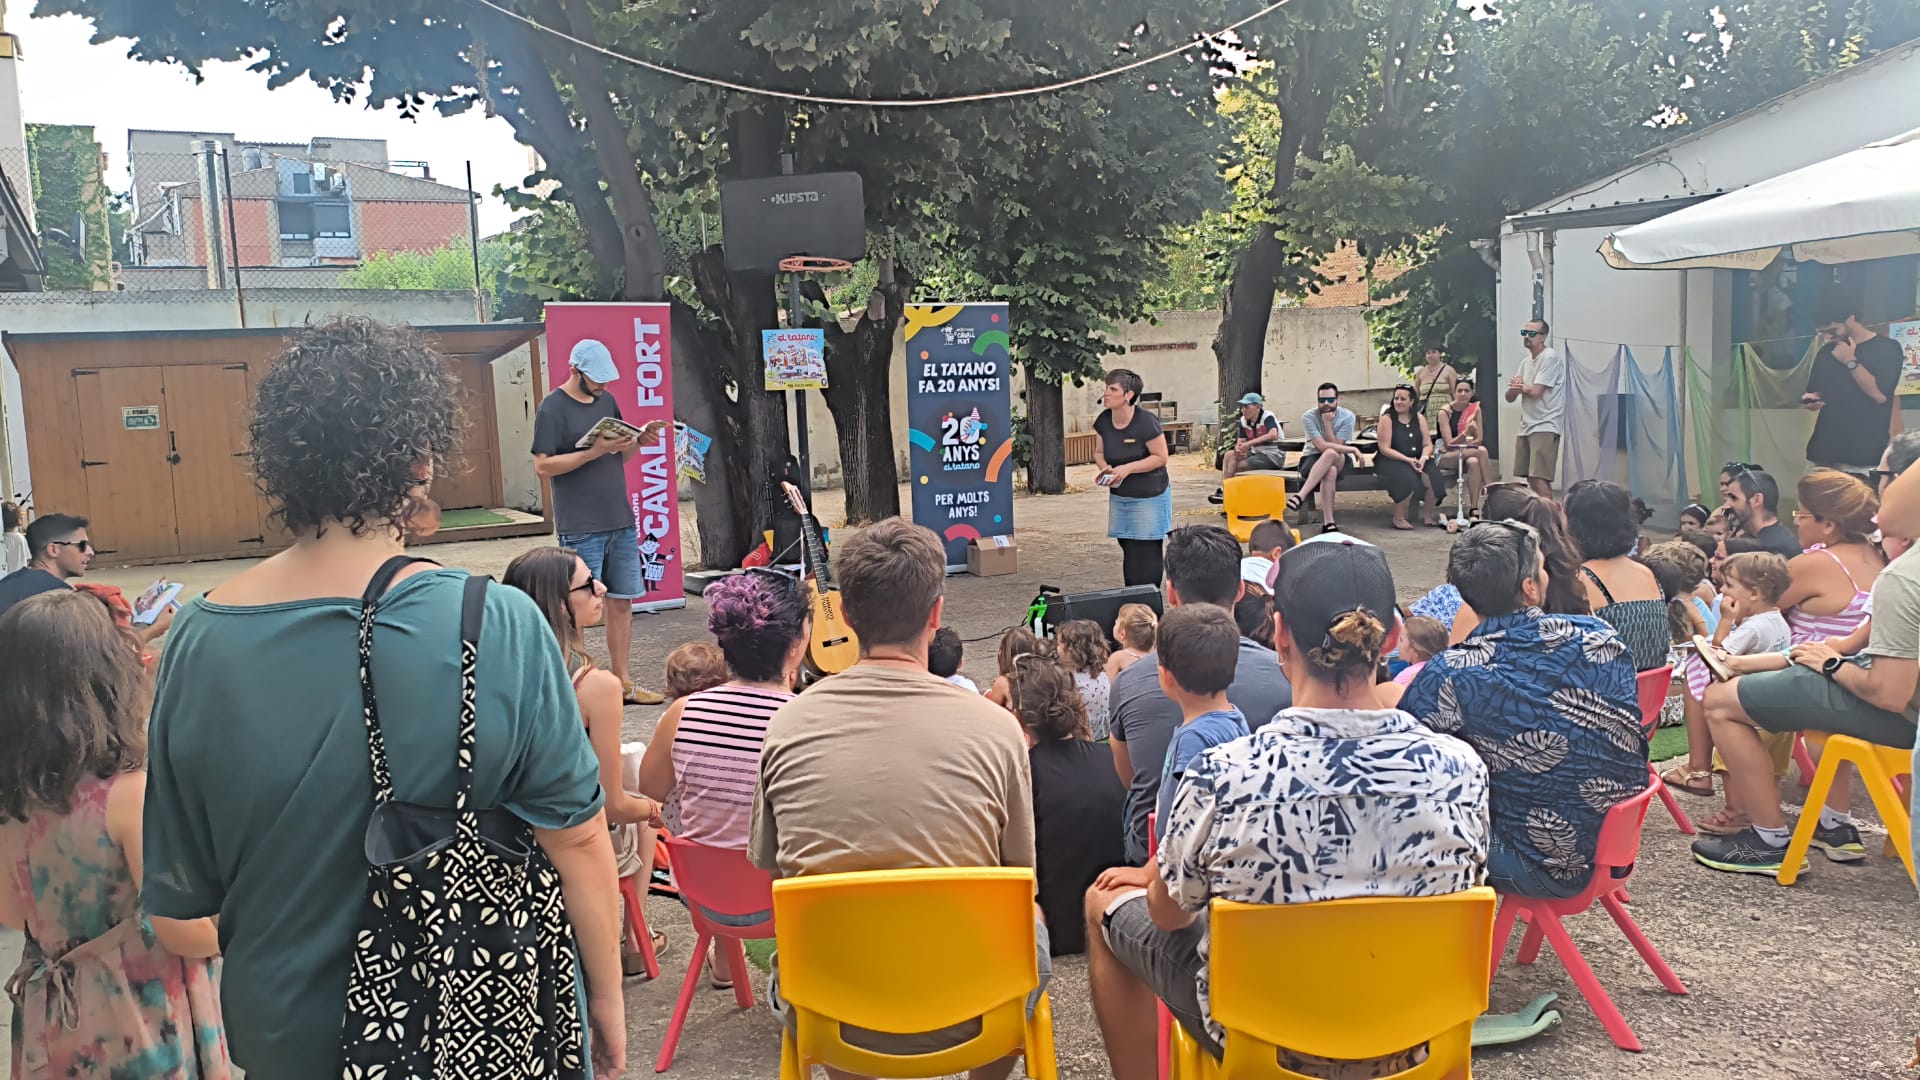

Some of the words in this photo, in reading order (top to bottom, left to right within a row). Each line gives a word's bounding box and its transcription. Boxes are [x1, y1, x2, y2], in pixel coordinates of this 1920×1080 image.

[634, 317, 664, 407] FORT
[923, 363, 938, 377] EL
[940, 361, 997, 376] TATANO
[918, 380, 936, 394] FA
[937, 379, 955, 393] 20
[957, 377, 1000, 392] ANYS!
[941, 416, 980, 445] 20
[943, 444, 980, 463] ANYS
[641, 427, 670, 539] CAVAL
[935, 493, 954, 506] PER
[957, 491, 989, 504] MOLTS
[949, 505, 978, 518] ANYS!
